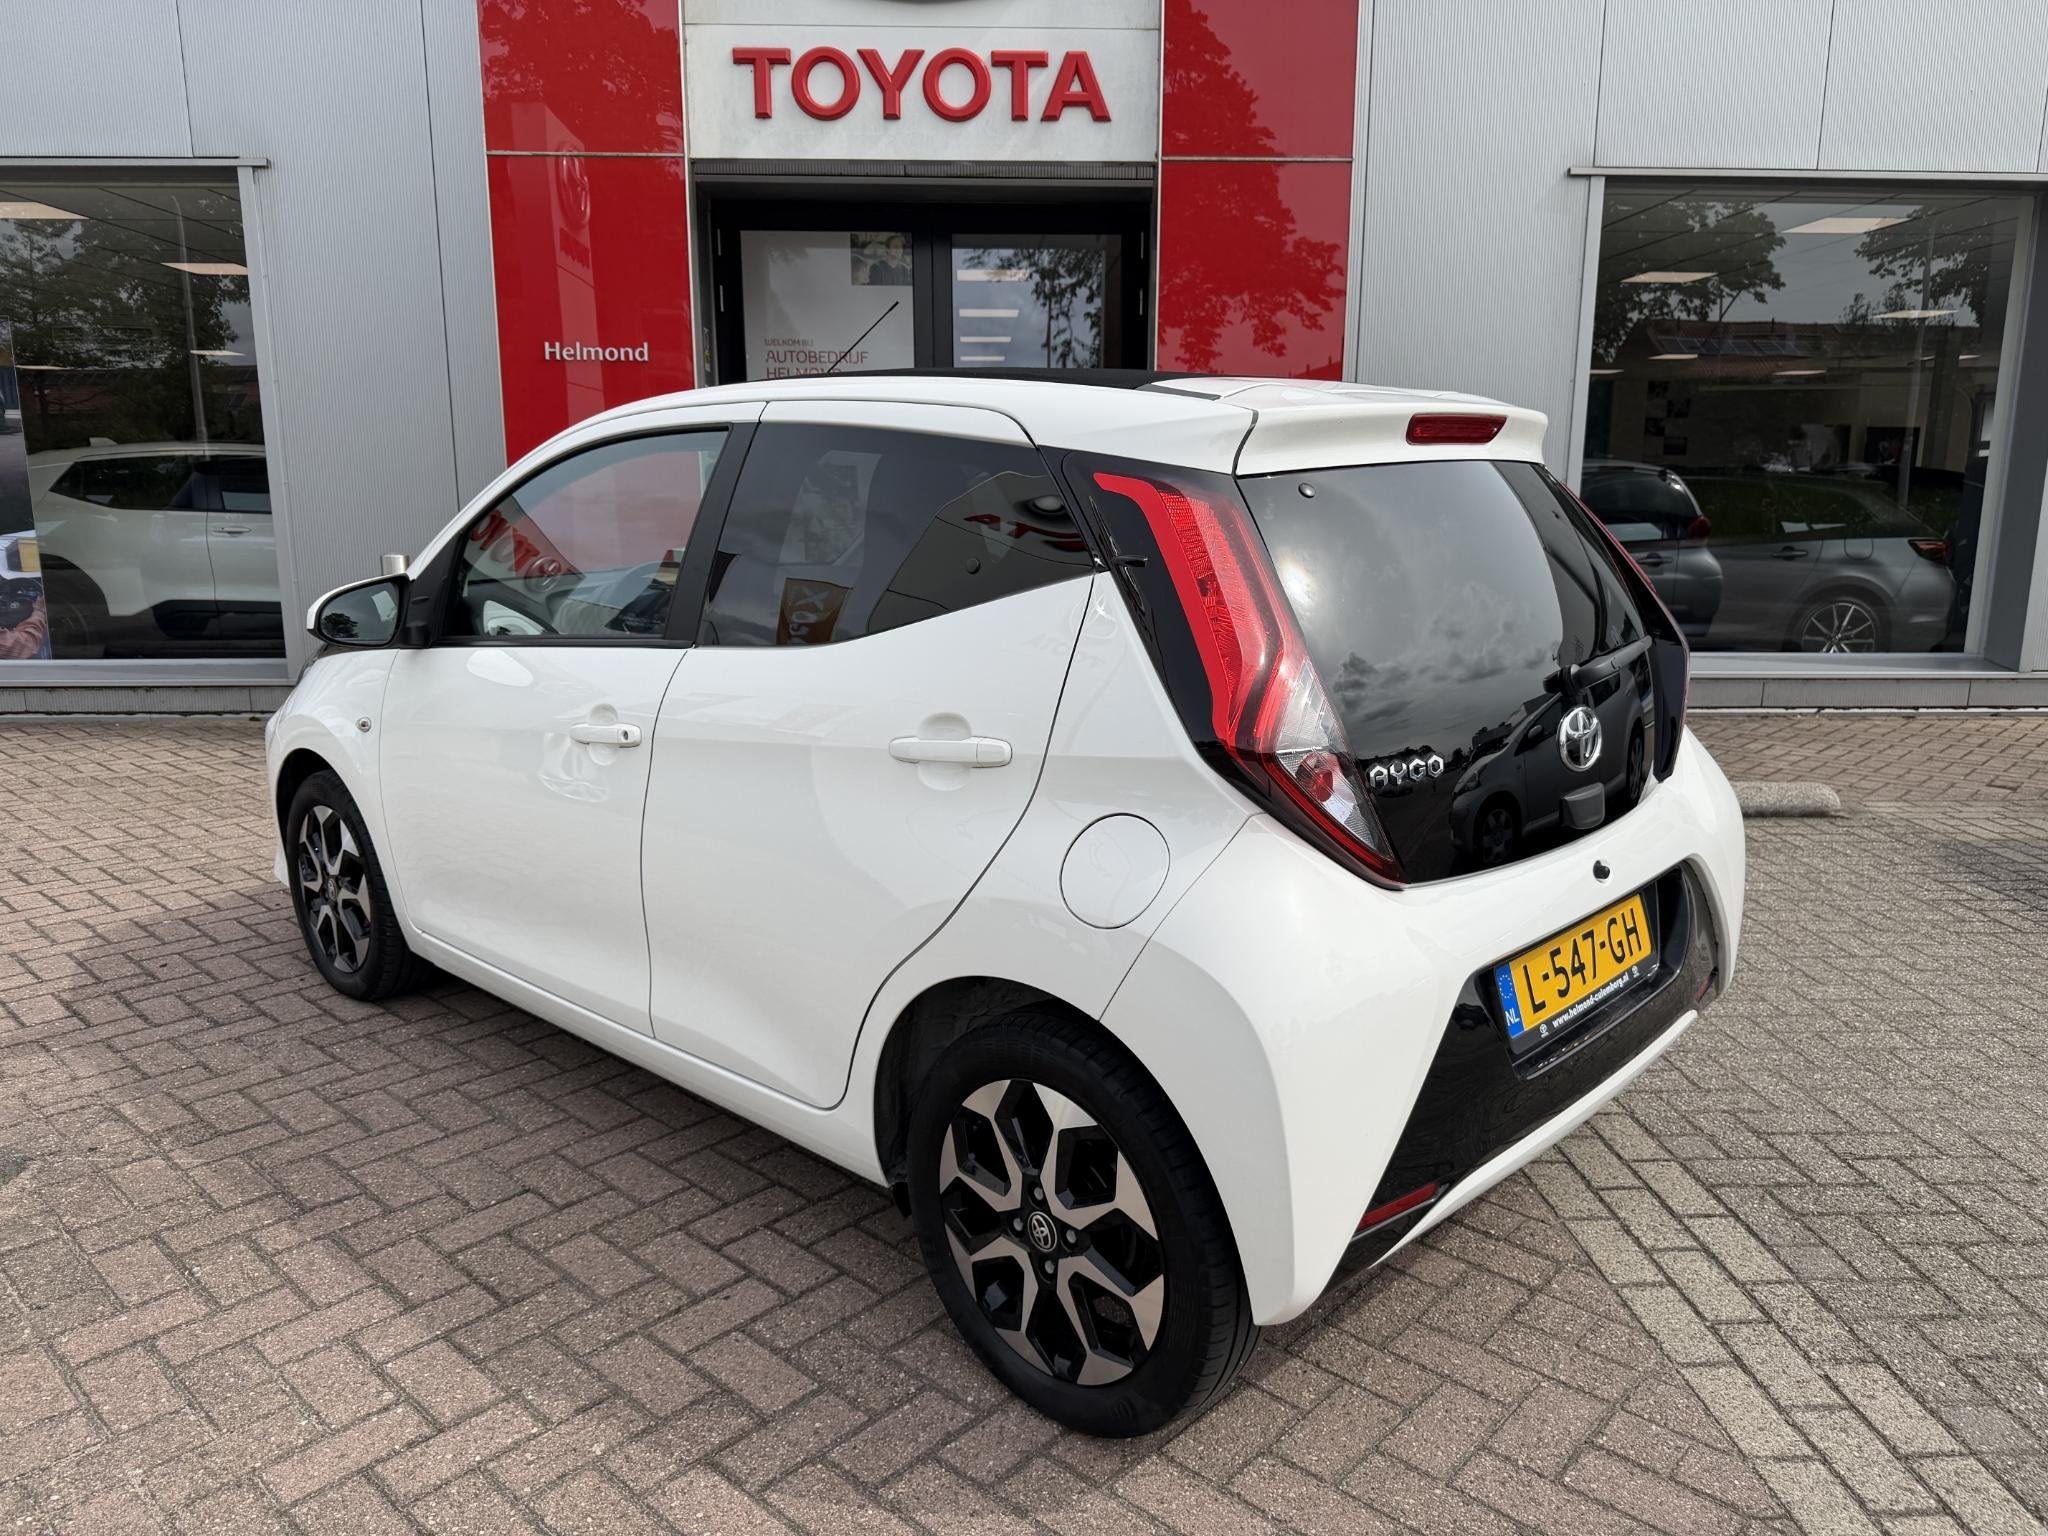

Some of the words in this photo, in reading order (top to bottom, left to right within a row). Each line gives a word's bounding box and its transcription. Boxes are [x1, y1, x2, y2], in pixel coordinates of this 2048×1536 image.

[732, 46, 1111, 122] TOYOTA
[544, 342, 649, 361] Helmond
[766, 350, 869, 364] AUTOBEDRIJF
[1369, 754, 1445, 789] AYGO
[1523, 908, 1642, 1015] L-547-GH
[1505, 1007, 1520, 1027] NL
